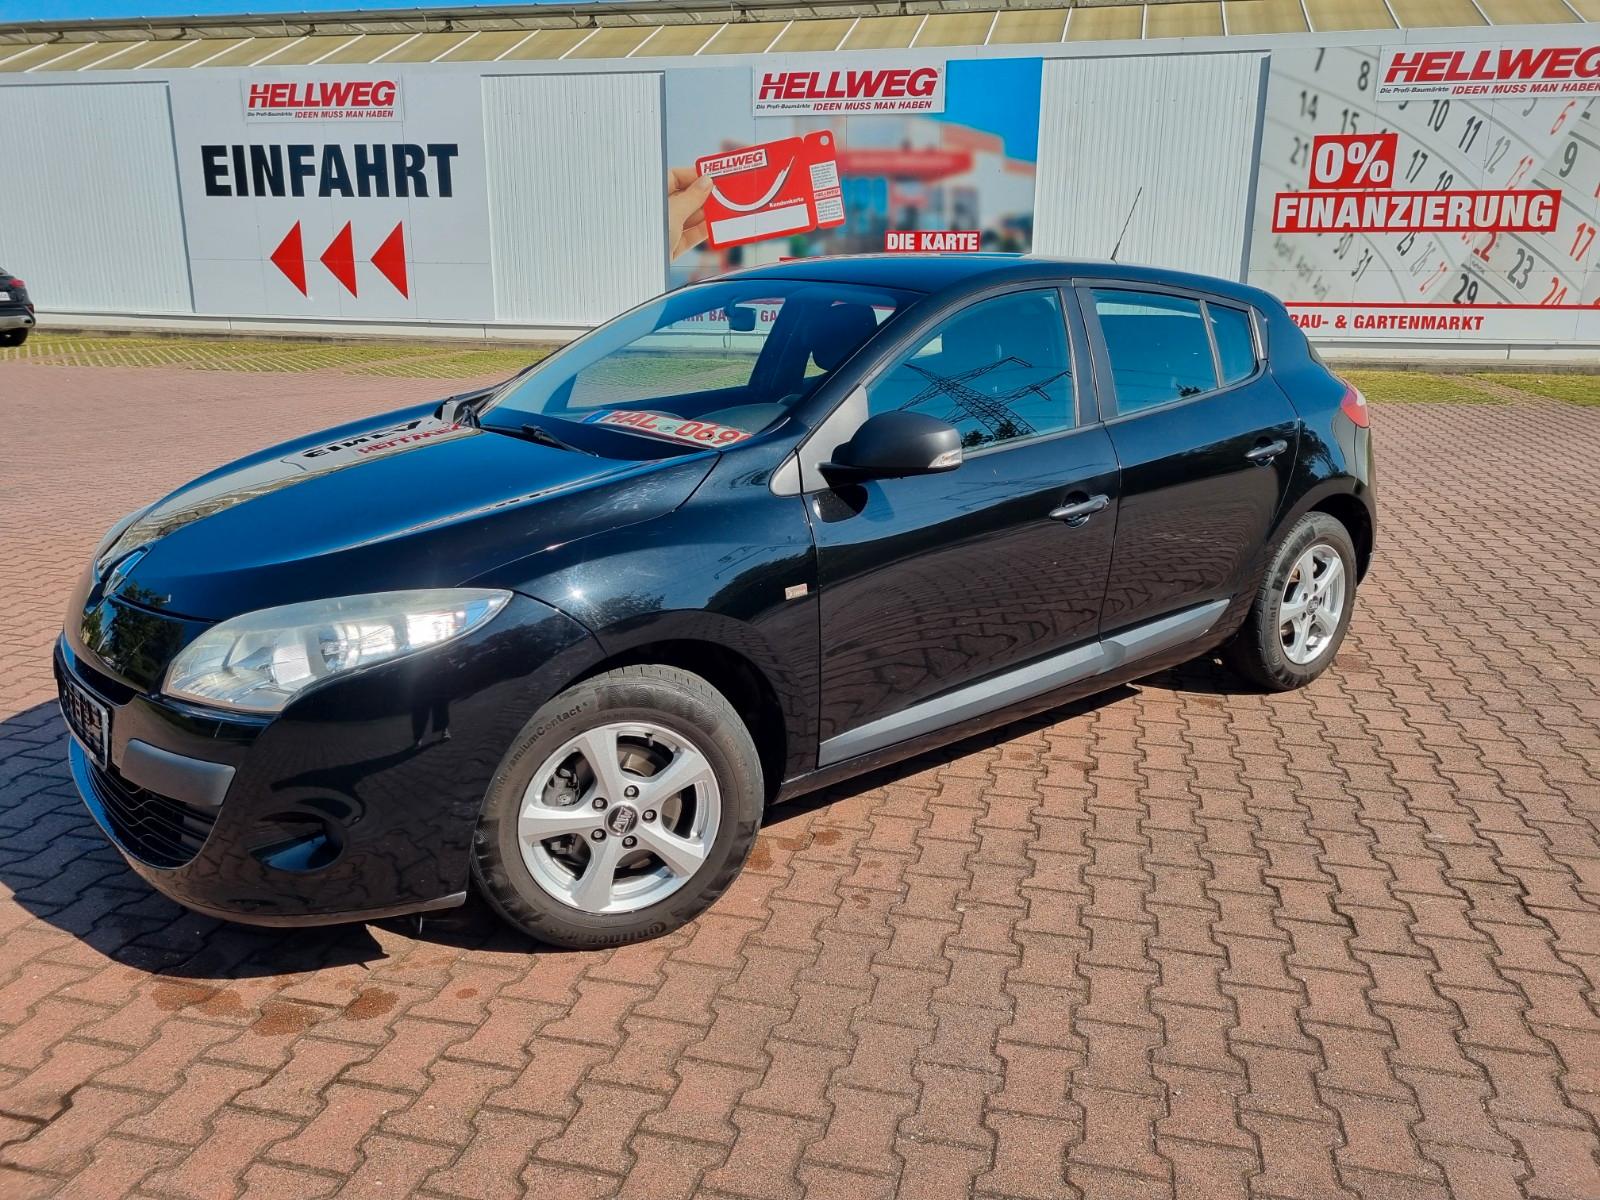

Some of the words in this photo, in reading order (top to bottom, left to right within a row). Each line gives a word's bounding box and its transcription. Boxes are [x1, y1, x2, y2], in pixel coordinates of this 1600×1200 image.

[1358, 60, 1370, 91] 8
[1384, 45, 1600, 83] HELLWEG
[248, 80, 396, 108] HELLWEG
[758, 67, 938, 100] HELLWEG
[1394, 86, 1449, 94] Profi-Baumärkte
[1452, 85, 1488, 95] IDEEN
[1491, 84, 1527, 94] MUSS
[1529, 83, 1558, 93] MAN
[321, 110, 343, 118] MUSS
[346, 110, 363, 118] MAN
[365, 110, 394, 118] HABEN
[813, 103, 843, 111] IDEEN
[844, 102, 871, 111] MUSS
[874, 101, 896, 110] MAN
[898, 101, 932, 110] HABEN
[1428, 99, 1450, 132] 10
[1458, 115, 1483, 153] 11
[200, 143, 459, 198] EINFAHRT
[703, 152, 763, 174] HELLWEG
[1314, 140, 1389, 185] 0%
[1405, 149, 1429, 184] 17
[1558, 141, 1578, 178] 9
[1276, 194, 1553, 229] FINANZIERUNG
[887, 233, 915, 250] DIE
[921, 233, 978, 250] KARTE
[1568, 222, 1597, 262] 17
[1507, 248, 1535, 290] 23
[1334, 314, 1348, 329] &
[1353, 314, 1485, 331] GARTENMARKT
[601, 410, 658, 430] HAL
